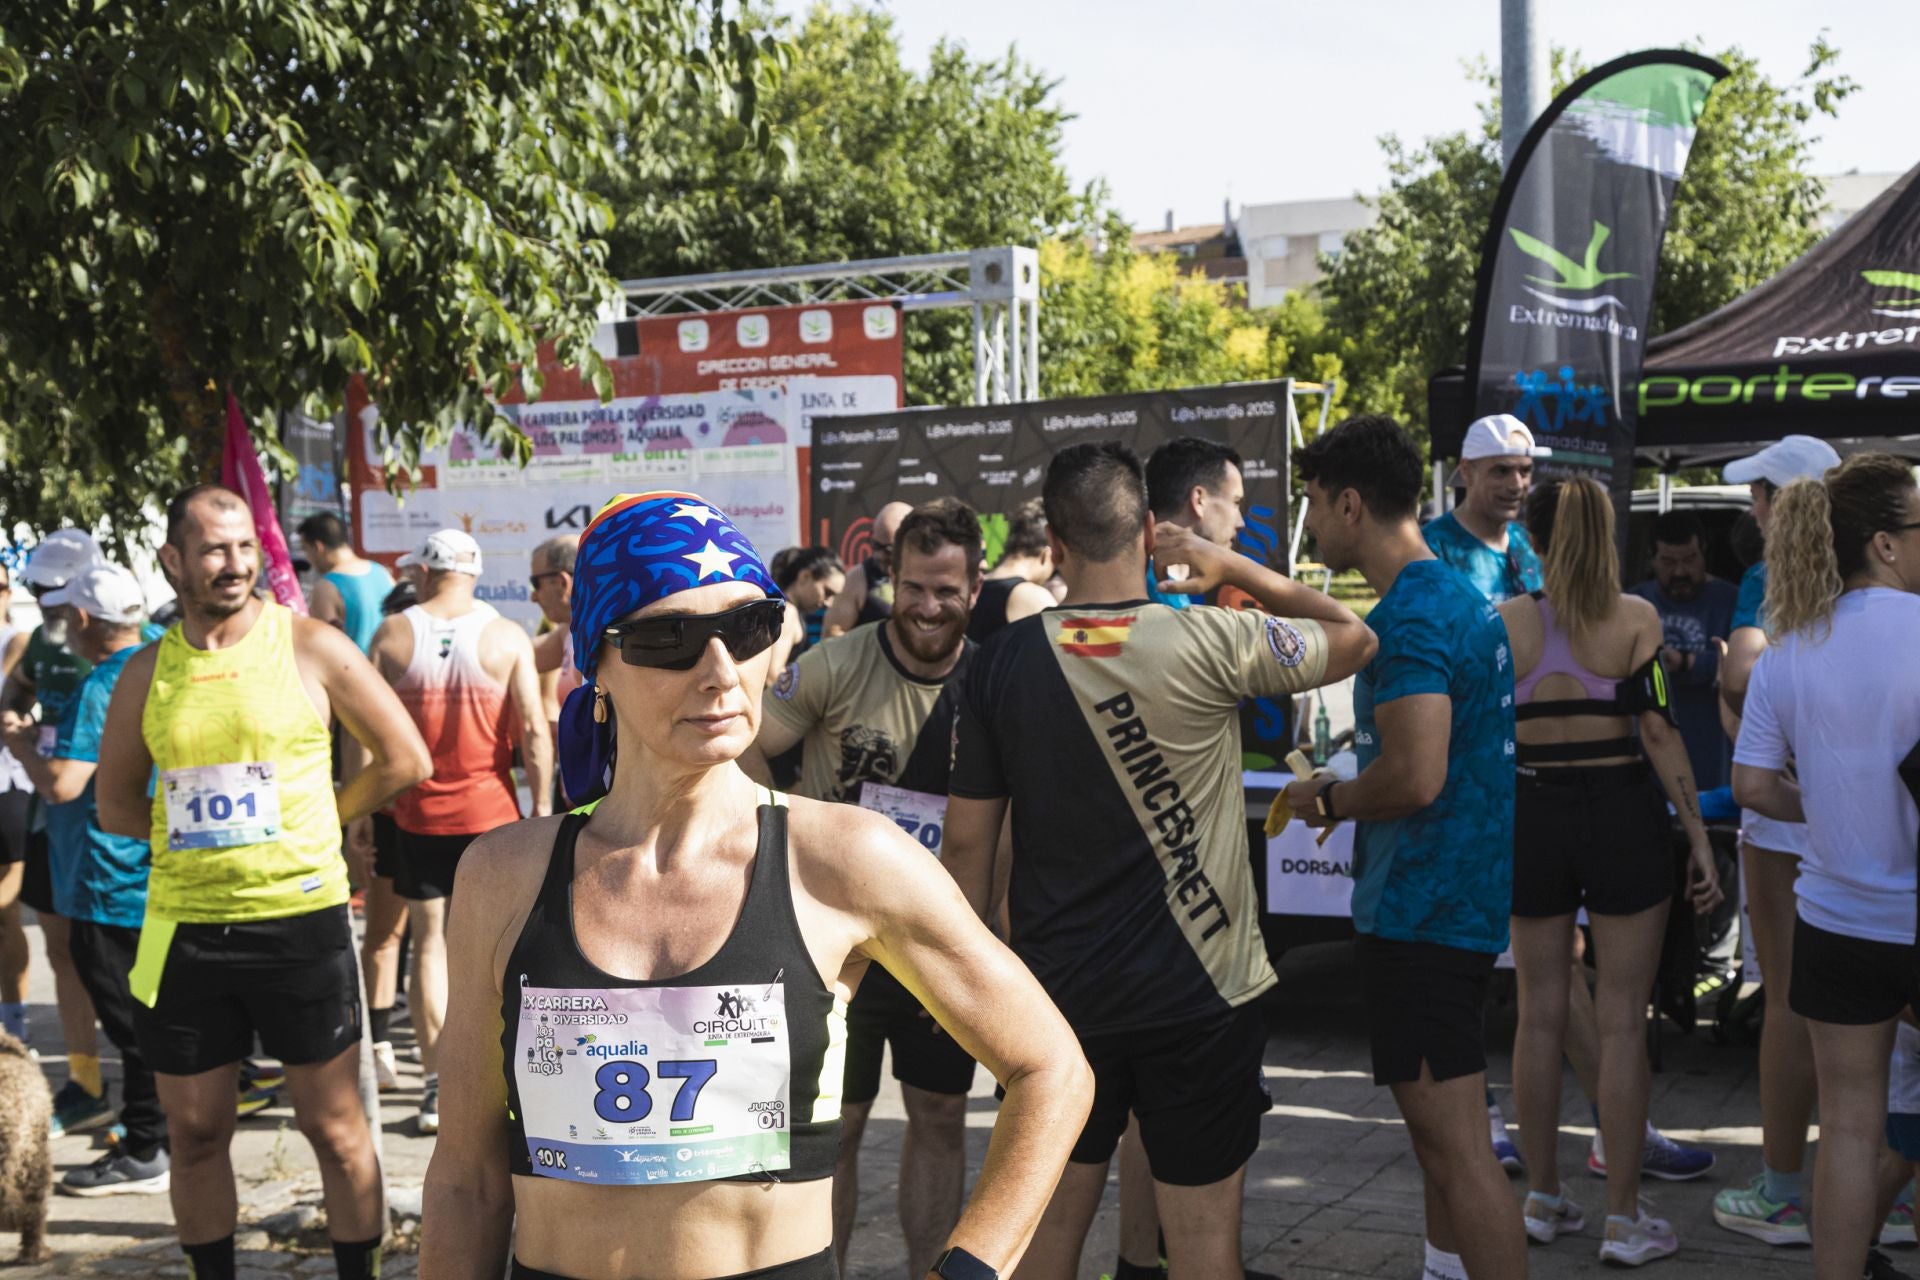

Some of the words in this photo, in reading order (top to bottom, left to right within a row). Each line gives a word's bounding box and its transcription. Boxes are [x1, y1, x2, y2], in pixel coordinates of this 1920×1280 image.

[1509, 304, 1638, 341] Extremadura
[769, 352, 838, 371] GENERAL
[842, 392, 857, 407] DE
[525, 410, 578, 428] CARRERA
[582, 408, 609, 424] POR
[609, 407, 625, 423] LA
[628, 403, 706, 421] DIVERSIDAD
[534, 430, 556, 447] LOS
[559, 427, 617, 445] PALOMOS
[627, 424, 684, 444] AQUALIA
[474, 579, 528, 601] qualia
[186, 792, 256, 823] 101
[538, 995, 608, 1012] CARRERA
[553, 1013, 628, 1026] DIVERSIDAD
[693, 1018, 767, 1034] CIRCUIT
[586, 1040, 648, 1060] aqualia
[594, 1059, 717, 1123] 87
[748, 1101, 784, 1112] JUNIO
[758, 1111, 784, 1129] 01
